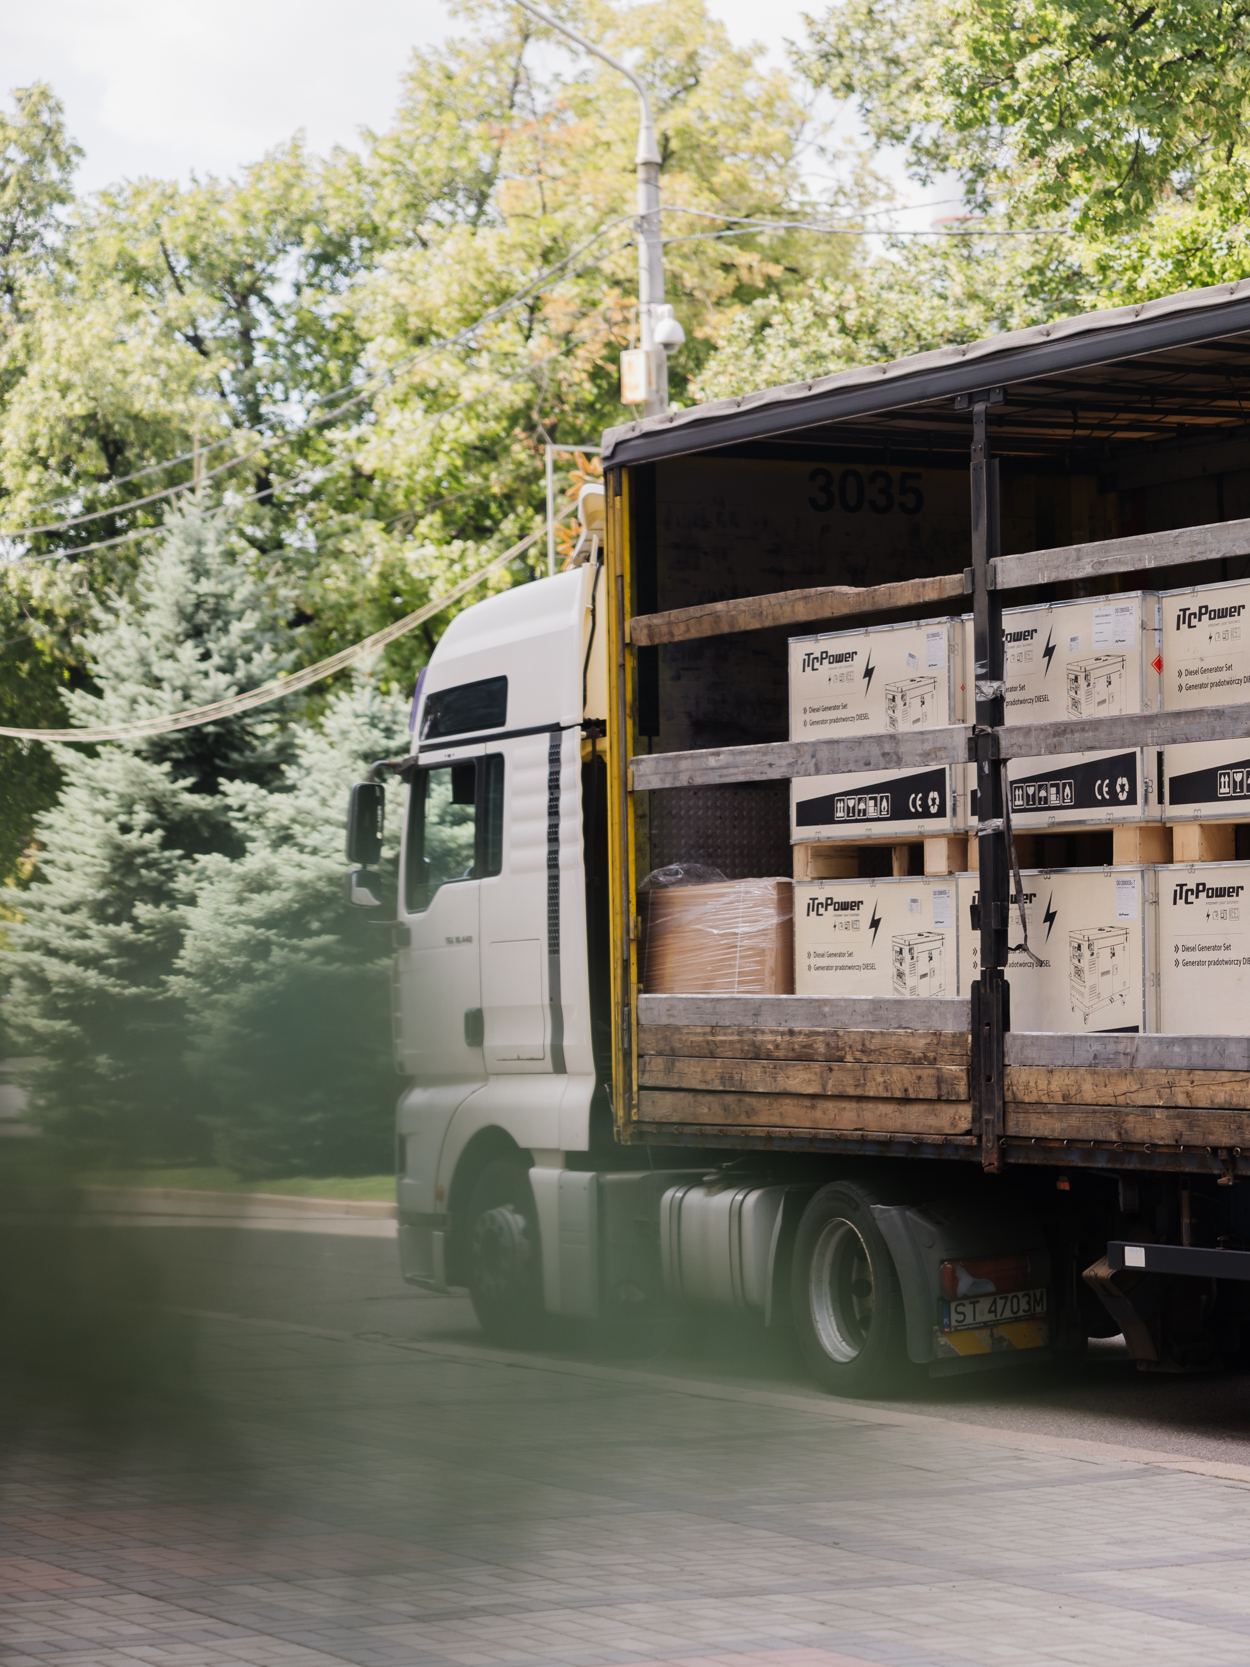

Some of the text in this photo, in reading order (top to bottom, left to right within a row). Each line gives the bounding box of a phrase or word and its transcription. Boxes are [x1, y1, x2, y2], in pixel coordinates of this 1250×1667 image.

[808, 467, 924, 515] 3035
[1184, 664, 1233, 678] Diesel Generator Set
[1006, 684, 1018, 694] erator
[1184, 681, 1209, 692] Generator
[1209, 676, 1243, 690] pradotwórczy
[1034, 694, 1050, 703] DIESEL
[808, 704, 822, 714] Diesel
[822, 702, 840, 712] Generator
[808, 717, 828, 727] Generator
[856, 713, 870, 722] DIESEL
[1182, 942, 1232, 952] Diesel Generator Set
[1182, 958, 1207, 967] Generator
[1208, 956, 1242, 968] pradotwórczy
[954, 1300, 980, 1324] ST
[987, 1289, 1044, 1318] 4703M
